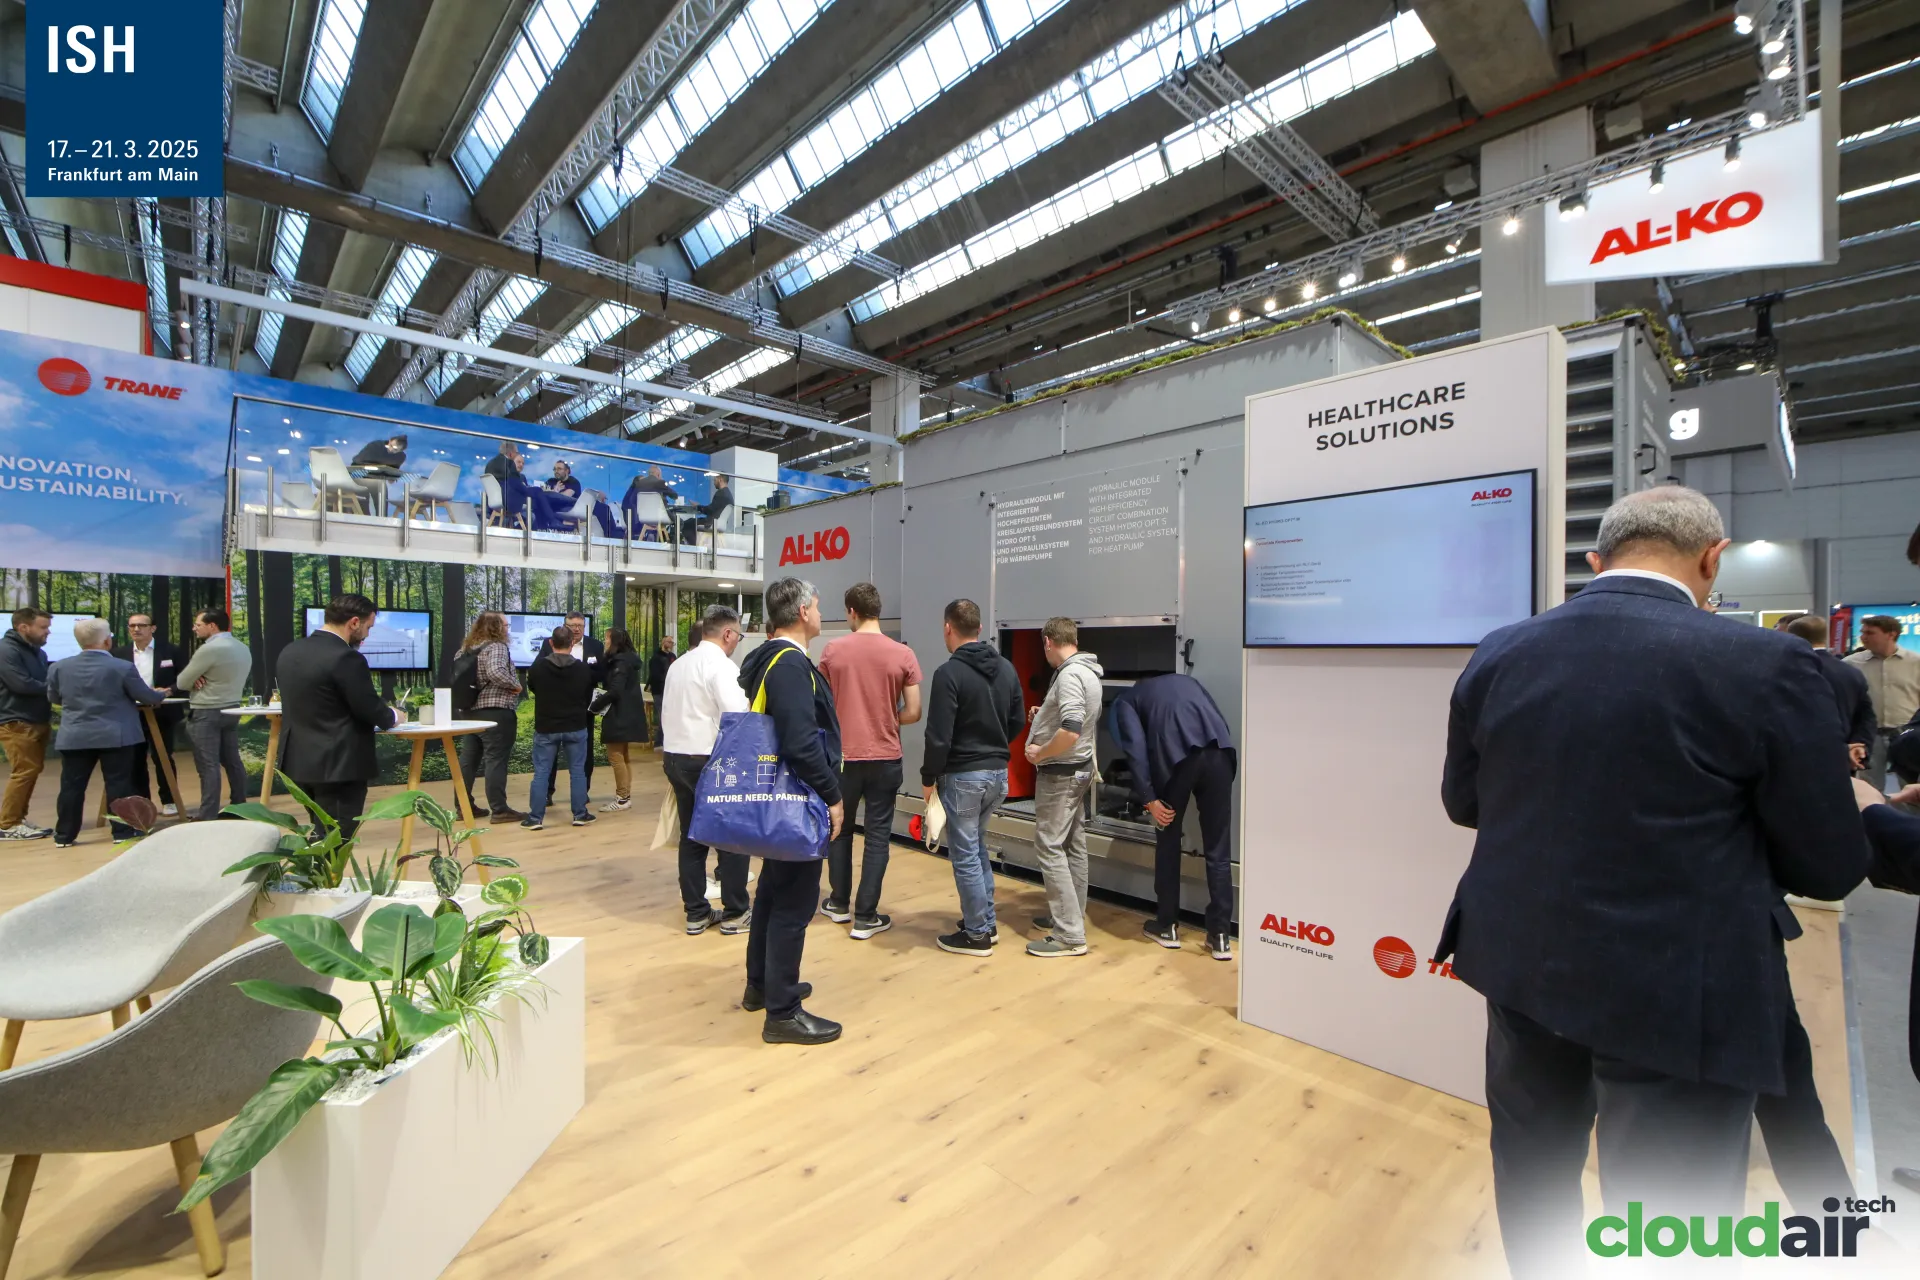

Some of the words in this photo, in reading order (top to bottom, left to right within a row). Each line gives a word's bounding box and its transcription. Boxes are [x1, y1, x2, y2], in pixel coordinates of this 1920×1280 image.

[1589, 191, 1764, 265] AL-KO
[104, 376, 183, 401] TRANE
[1307, 381, 1466, 429] HEALTHCARE
[1315, 411, 1455, 451] SOLUTIONS
[1669, 407, 1699, 441] g
[1088, 480, 1129, 494] HYDRAULIC
[1129, 474, 1161, 487] MODULE
[997, 494, 1052, 510] HYDRAULIKMODUL
[1053, 491, 1065, 500] MIT
[1088, 495, 1106, 504] WITH
[1107, 487, 1152, 501] INTEGRATED
[997, 505, 1040, 518] INTEGRIERTEM
[997, 513, 1052, 528] HOCHEFFIZIENTEM
[1088, 513, 1115, 525] CIRCUIT
[1116, 506, 1169, 520] COMBINATION
[996, 518, 1083, 537] KREISLAUFVERBUNDSYSTEM
[1088, 524, 1116, 535] SYSTEM
[1116, 520, 1143, 531] HYDRO
[1144, 518, 1160, 528] OPT
[1161, 517, 1167, 526] S
[996, 537, 1018, 546] HYDRO
[1018, 535, 1032, 543] OPT
[1032, 534, 1037, 542] S
[1088, 536, 1104, 545] AND
[1104, 530, 1146, 543] HYDRAULIC
[1147, 527, 1177, 539] SYSTEM
[778, 525, 851, 568] AL-KO
[996, 547, 1010, 555] UND
[1010, 540, 1070, 554] HYDRAULIKSYSTEM
[1088, 546, 1103, 555] FOR
[1103, 544, 1122, 553] HEAT
[1123, 541, 1145, 551] PUMP
[706, 794, 743, 804] NATURE
[745, 793, 773, 803] NEEDS
[1259, 913, 1335, 947] AL-KO
[1259, 936, 1295, 950] QUALITY
[1295, 946, 1314, 956] FOR
[1315, 950, 1334, 961] LIFE
